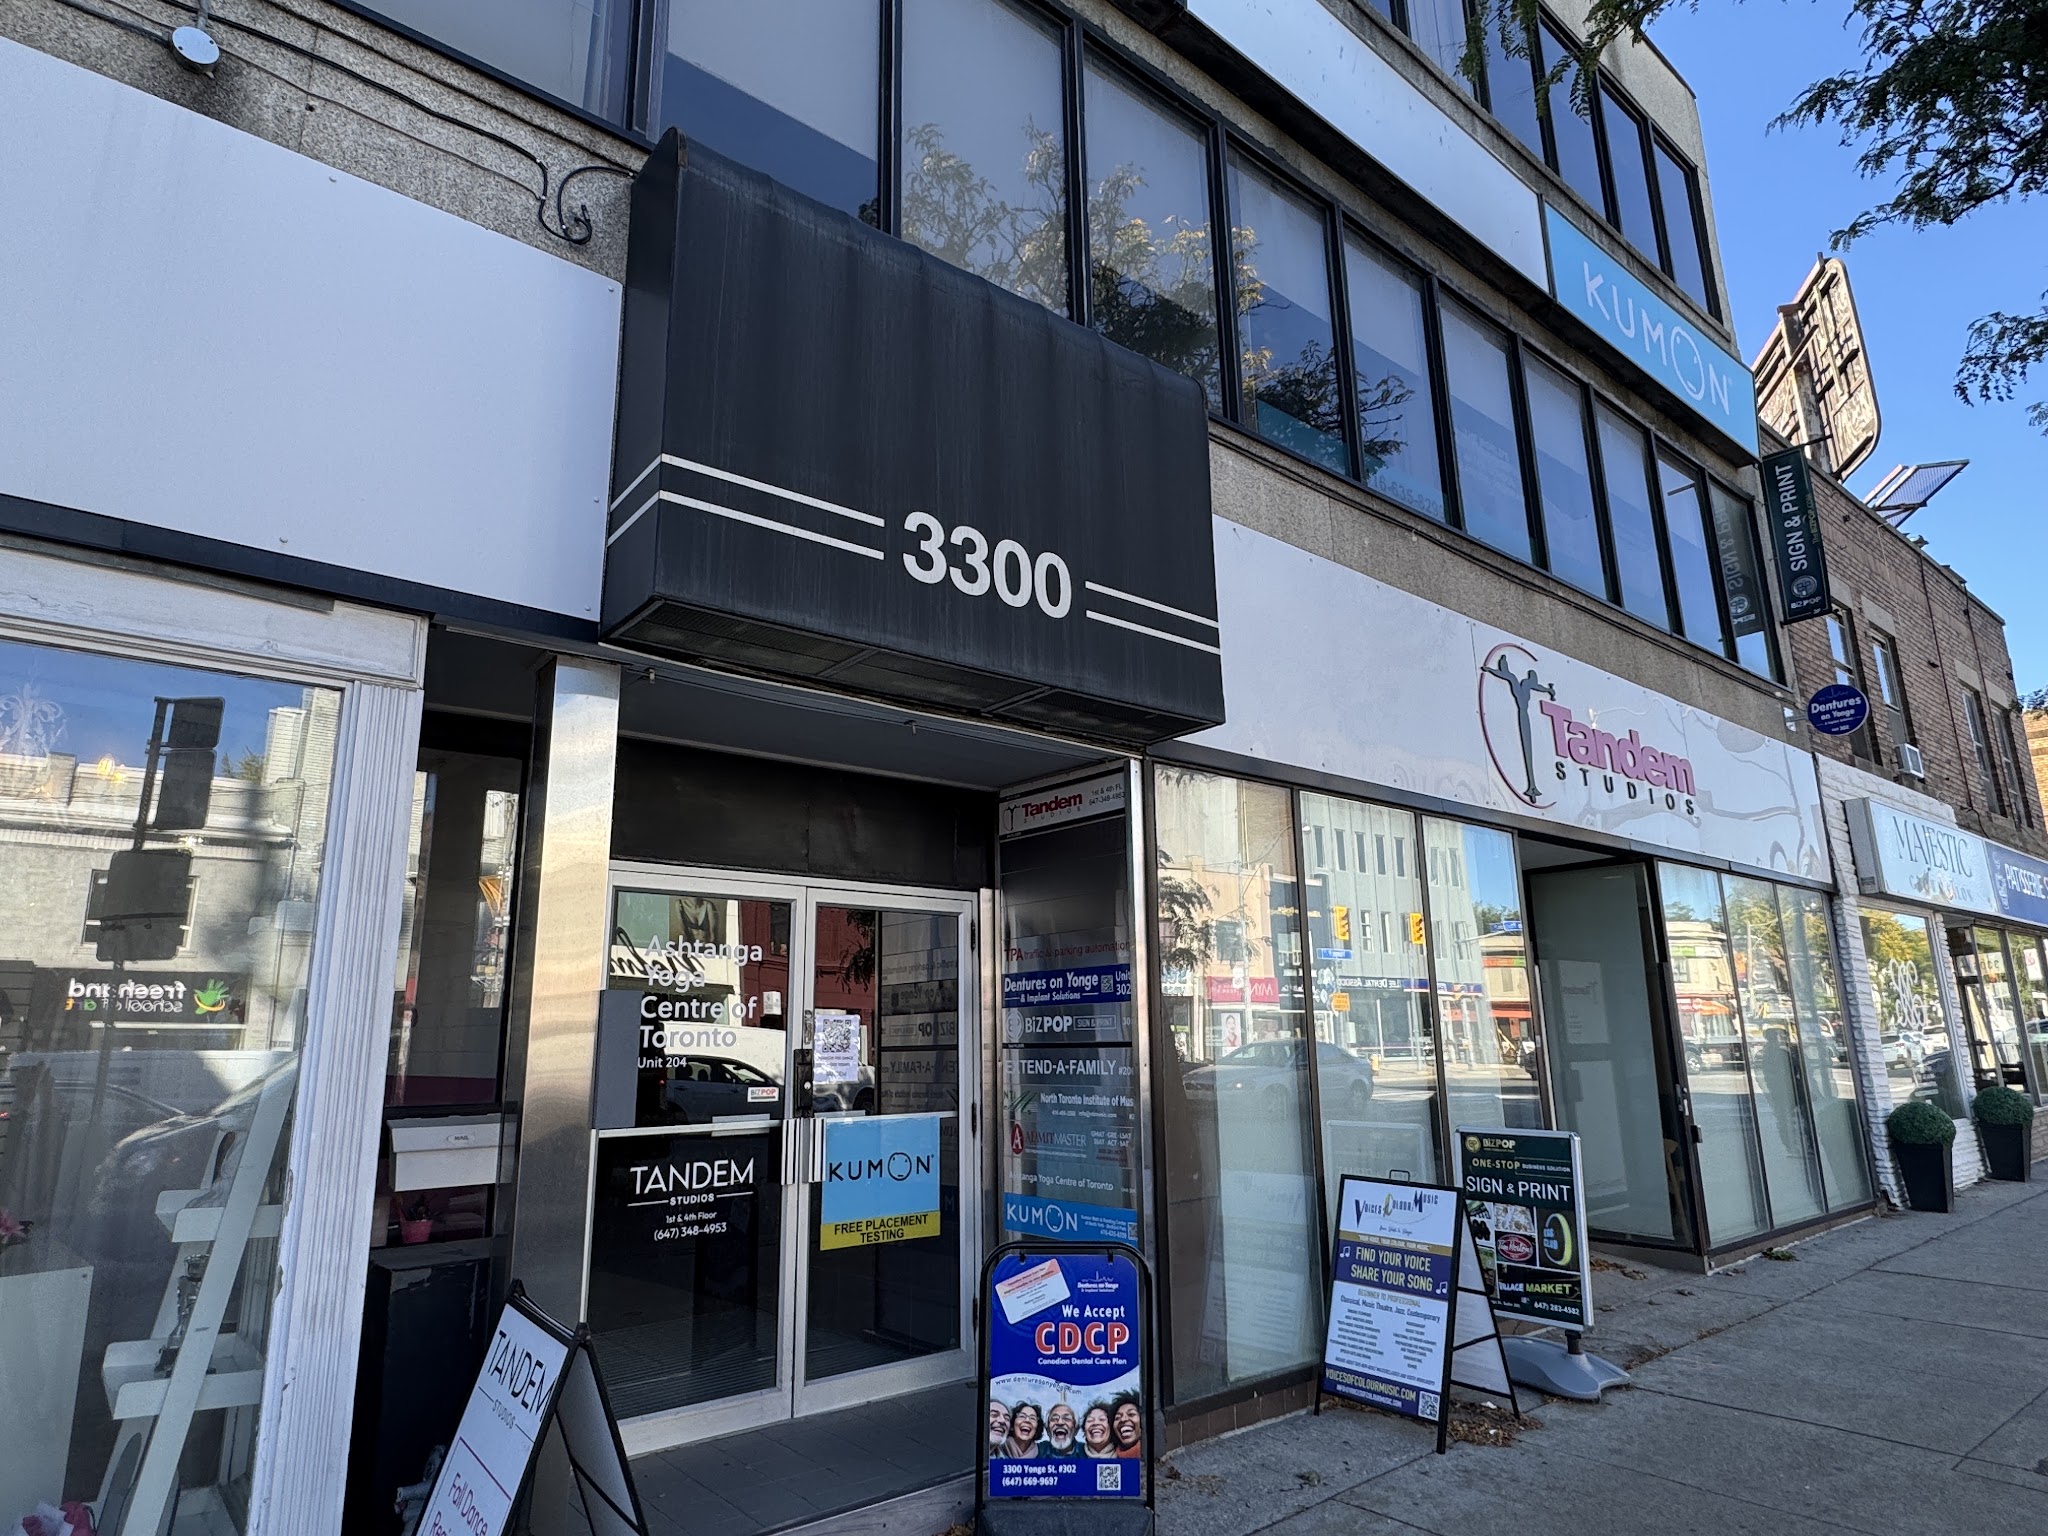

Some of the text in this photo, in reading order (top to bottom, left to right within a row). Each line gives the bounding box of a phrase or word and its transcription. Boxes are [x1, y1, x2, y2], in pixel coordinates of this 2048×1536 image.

[1583, 261, 1730, 415] KUMON
[1775, 465, 1808, 572] SIGN & PRINT
[902, 510, 1072, 619] 3300
[1811, 696, 1862, 714] Dentures
[1820, 708, 1856, 721] on Yonge
[1540, 700, 1697, 797] Tandem
[1555, 761, 1695, 815] STUDIOS
[1022, 793, 1083, 818] Tandem
[1892, 816, 1973, 878] MAJESTIC
[645, 935, 763, 966] Ashtanga
[1004, 948, 1024, 962] TPA
[1054, 945, 1083, 958] parking
[645, 963, 706, 993] Yoga
[1004, 977, 1047, 993] Dentures
[1050, 977, 1063, 989] on
[1066, 971, 1099, 991] Yonge
[640, 996, 758, 1019] Centre of
[1020, 991, 1081, 1004] & Implant Solutions
[1122, 1017, 1131, 1026] 30
[639, 1025, 738, 1049] Toronto
[637, 1056, 687, 1069] Unit 204
[1040, 1093, 1058, 1104] North
[1059, 1094, 1082, 1105] Toronto
[1083, 1095, 1111, 1106] Institute
[1112, 1096, 1119, 1107] of
[630, 1157, 755, 1195] TANDEM
[828, 1152, 931, 1182] KUMON
[1472, 1158, 1521, 1170] ONE-STOP
[1038, 1173, 1114, 1191] Yoga Centre of Toronto
[1466, 1176, 1572, 1201] SIGN & PRINT
[669, 1193, 715, 1206] STUDIOS
[665, 1211, 718, 1224] 1st & 4th Floor
[834, 1213, 929, 1236] FREE PLACEMENT
[1006, 1203, 1078, 1233] KUMON
[653, 1222, 727, 1241] (647) 348-4953
[860, 1228, 905, 1244] TESTING
[1355, 1246, 1431, 1272] FIND YOUR VOICE
[1350, 1264, 1433, 1292] SHARE YOUR SONG
[1525, 1283, 1572, 1295] MARKET
[1062, 1304, 1080, 1318] We
[1084, 1304, 1125, 1320] Accept
[1035, 1321, 1130, 1355] CDCP
[487, 1331, 559, 1423] TANDEM
[1325, 1368, 1417, 1402] VOICESOFCOLOURMUSIC.COM
[492, 1400, 516, 1429] STUDIOS
[1002, 1476, 1058, 1486] (647) 669-9697
[1003, 1465, 1077, 1475] 3300 Yonge St. #302
[447, 1473, 489, 1536] Fall Dance
